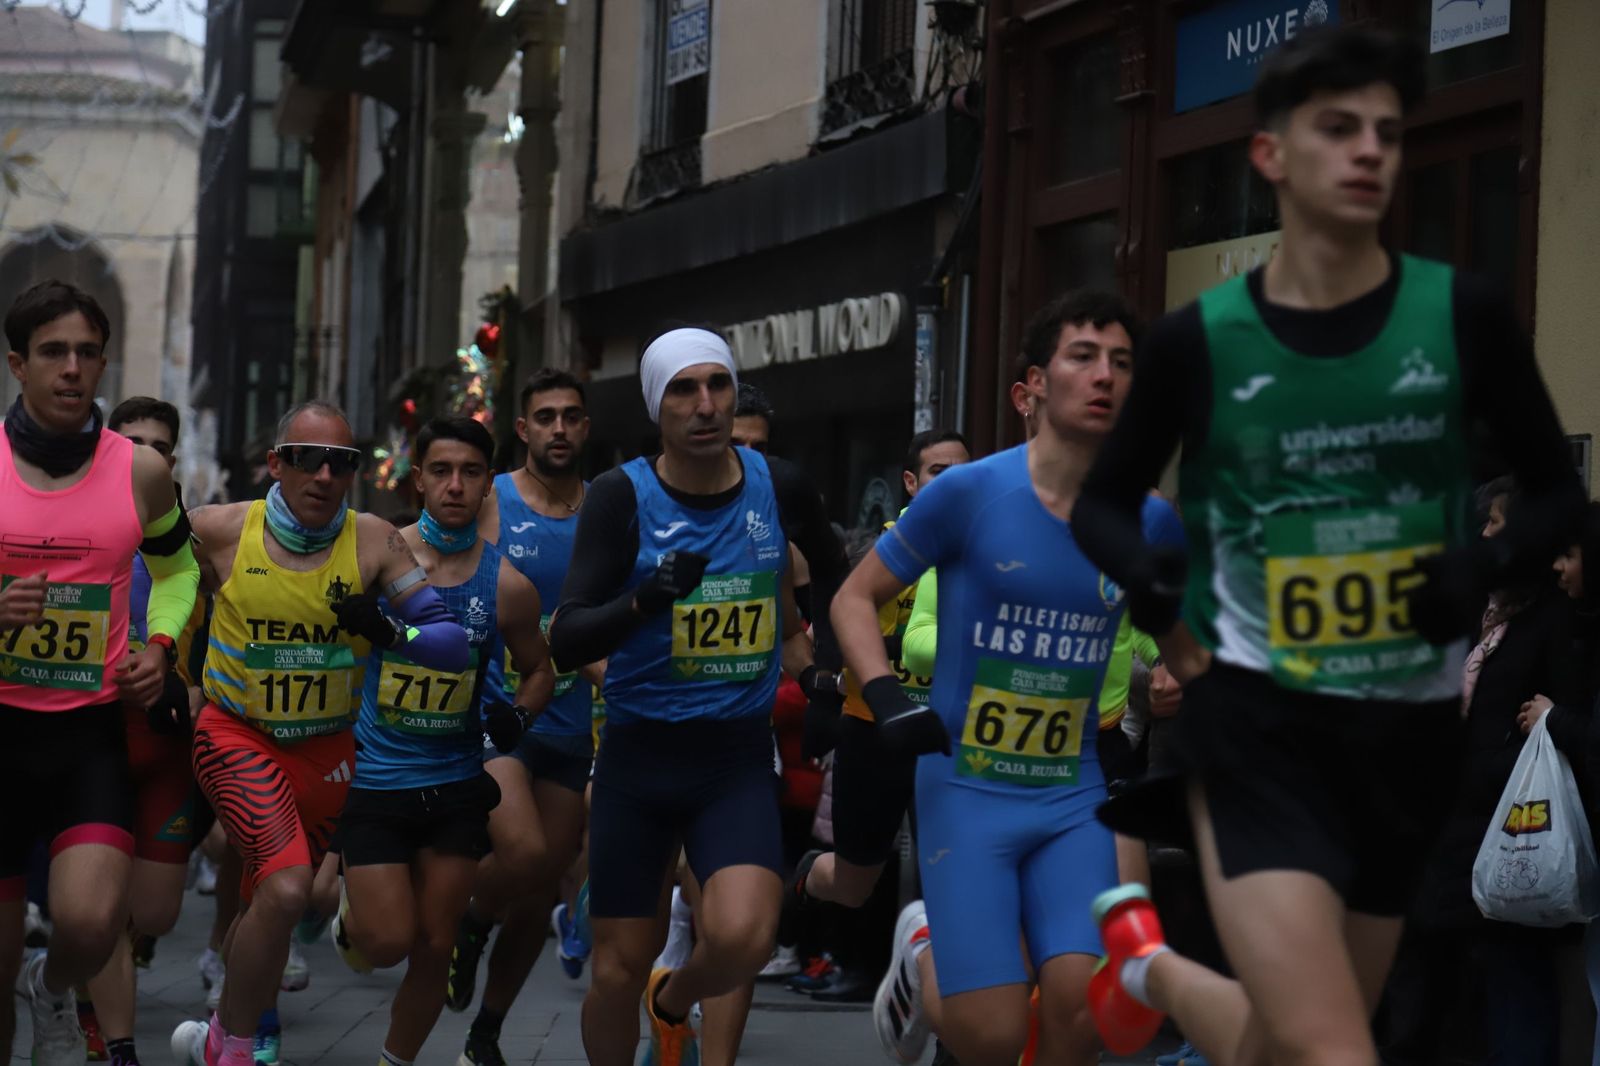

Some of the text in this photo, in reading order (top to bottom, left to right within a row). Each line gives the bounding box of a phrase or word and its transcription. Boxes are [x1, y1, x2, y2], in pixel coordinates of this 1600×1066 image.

[1226, 8, 1299, 61] NUXE
[1464, 24, 1473, 34] de
[818, 291, 901, 358] WORLD
[1280, 413, 1445, 452] universidad
[54, 595, 81, 604] RURAL
[1281, 567, 1427, 641] 695
[246, 618, 339, 643] TEAM
[681, 604, 763, 649] 1247
[997, 603, 1108, 632] ATLETISMO
[973, 621, 1109, 663] LAS ROZAS
[274, 656, 325, 664] CAJA RURAL
[703, 663, 732, 674] CAJA
[20, 666, 95, 684] CAJA RURAL
[260, 673, 327, 712] 1171
[392, 672, 459, 711] 717
[273, 727, 302, 738] CAJA
[402, 716, 427, 727] CAJA
[975, 700, 1071, 755] 676
[993, 760, 1072, 777] CAJA RURAL
